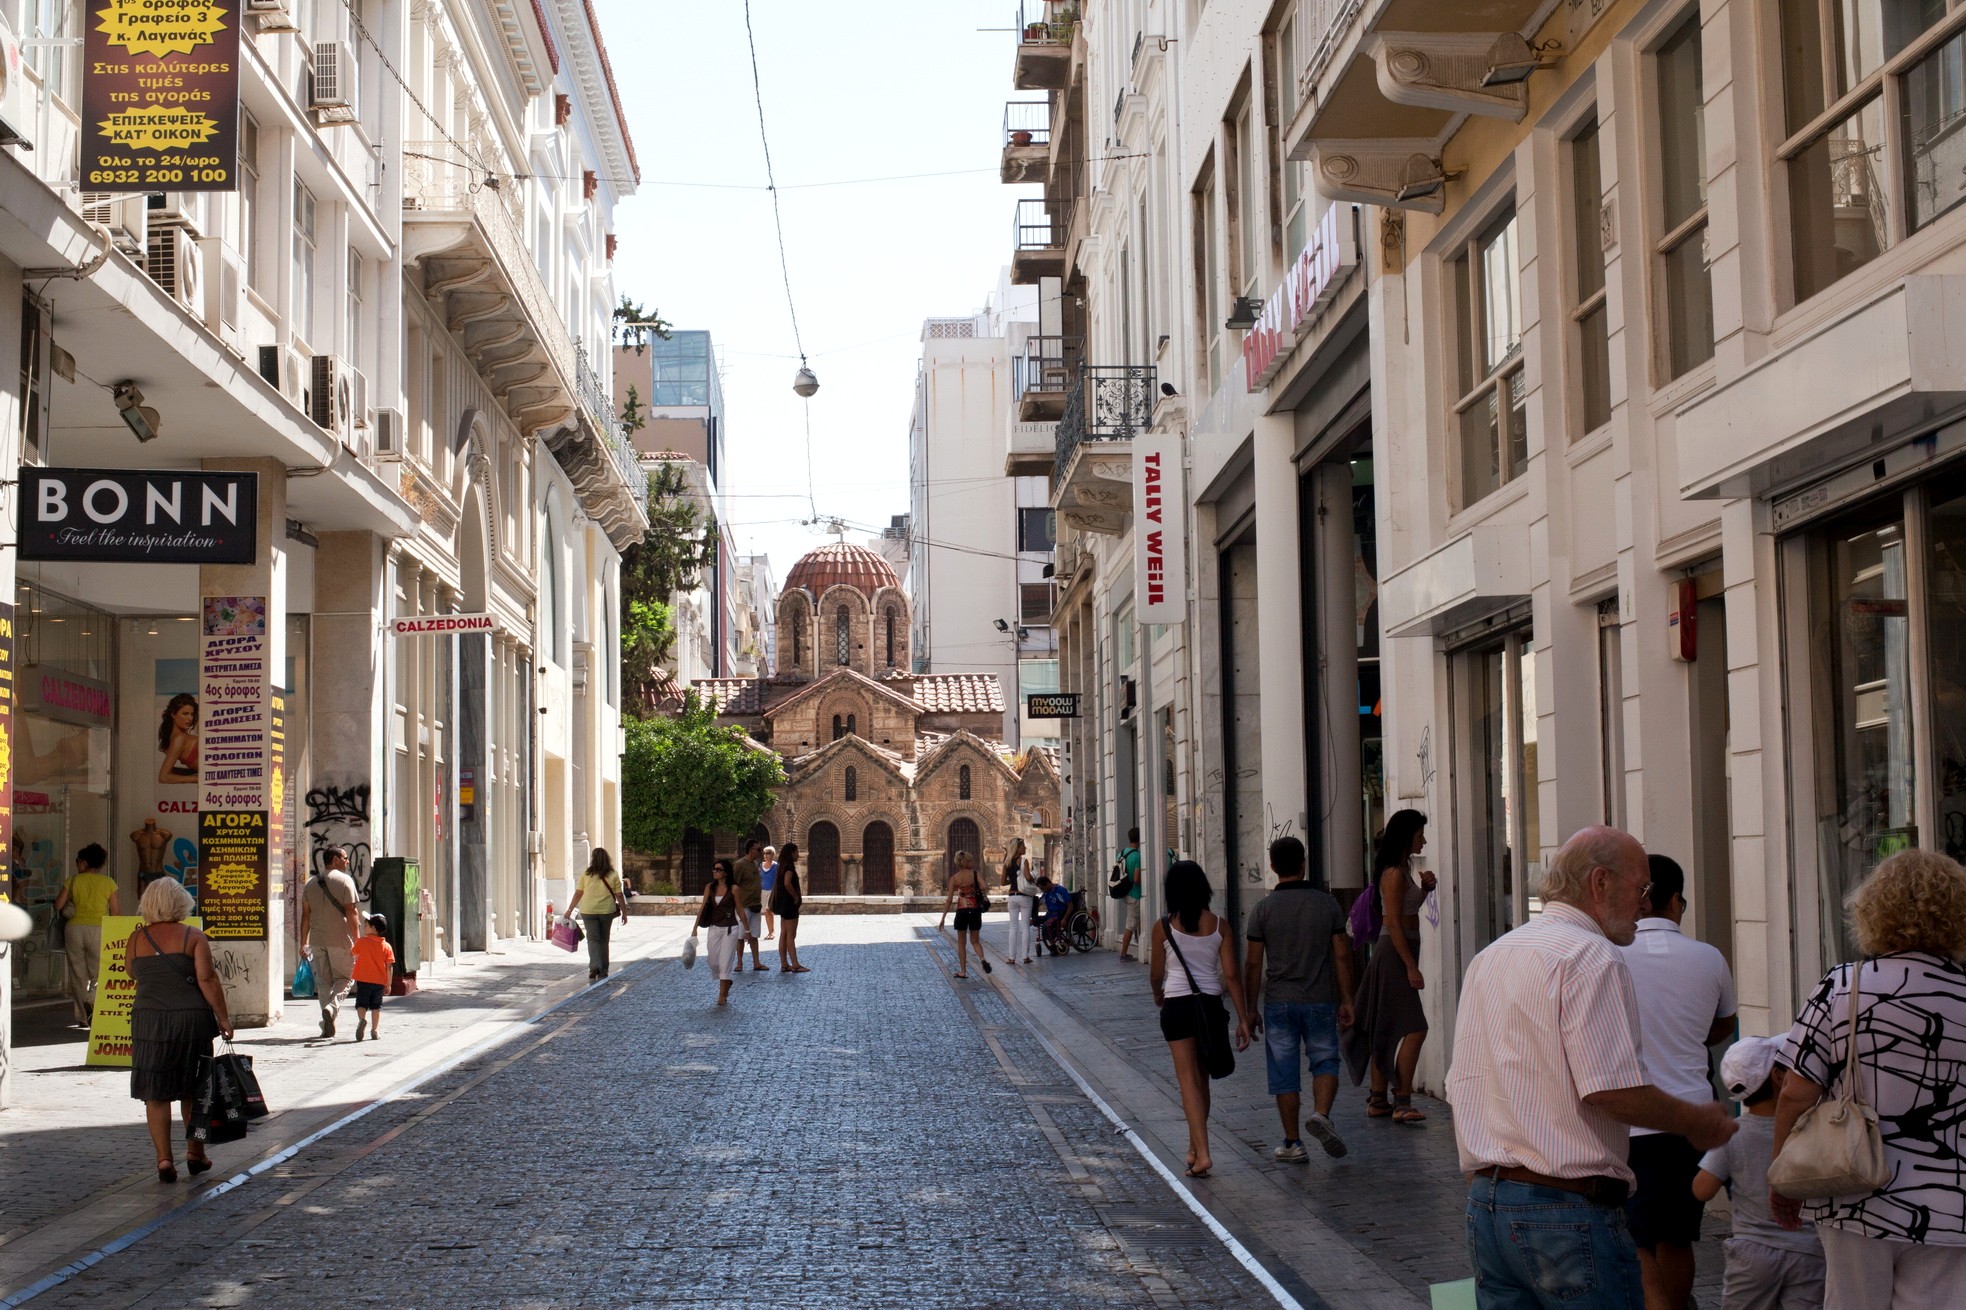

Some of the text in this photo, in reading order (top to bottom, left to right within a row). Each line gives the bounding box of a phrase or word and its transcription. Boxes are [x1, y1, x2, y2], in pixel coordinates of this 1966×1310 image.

[117, 11, 208, 26] Γραφείο 3
[116, 29, 208, 44] κ. Λαγανάς
[92, 61, 230, 76] Στις καλύτερες
[137, 75, 184, 90] τιμές
[109, 88, 212, 103] της αγοράς
[111, 114, 205, 126] ΕΠΙΣΚΕΨΕΙΣ
[151, 128, 202, 140] ΟΙΚΟΝ
[136, 157, 156, 166] το
[160, 155, 220, 168] 24/ωρο
[89, 168, 228, 184] 6932 200 100
[1144, 451, 1163, 524] TALLY
[36, 478, 239, 527] BONN
[56, 526, 219, 554] Feel the inspiration
[395, 616, 495, 633] CALZEDONIA
[207, 635, 258, 649] ΑΓΟΡΑ
[204, 643, 263, 658] ΧΡΥΣΟΥ
[203, 662, 263, 674] ΜΕΤΡΗΤΑ ΑΜΕΣΑ
[41, 674, 111, 718] CALZEDONIA
[204, 683, 261, 699] 4ος όροφος
[211, 704, 256, 718] ΑΓΟΡΕΣ
[204, 713, 263, 728] ΠΩΛΗΣΕΙΣ
[204, 733, 264, 745] ΚΟΣΜΗΜΑΤΩΝ
[204, 750, 263, 762] ΡΟΛΟΓΙΩΝ
[205, 791, 223, 808] 4ος
[224, 791, 262, 808] όροφος
[203, 813, 264, 827] ΑΓΟΡΑ
[216, 828, 251, 836] ΧΡΥΣΟΥ
[202, 837, 265, 845] ΚΟΣΜΗΜΑΤΩΝ
[209, 846, 257, 854] ΑΣΗΜΙΚΩΝ
[223, 854, 258, 862] ΠΩΛΗΣΗ
[222, 896, 262, 905] καλύτερες
[200, 904, 266, 913] τιμές της αγοράς
